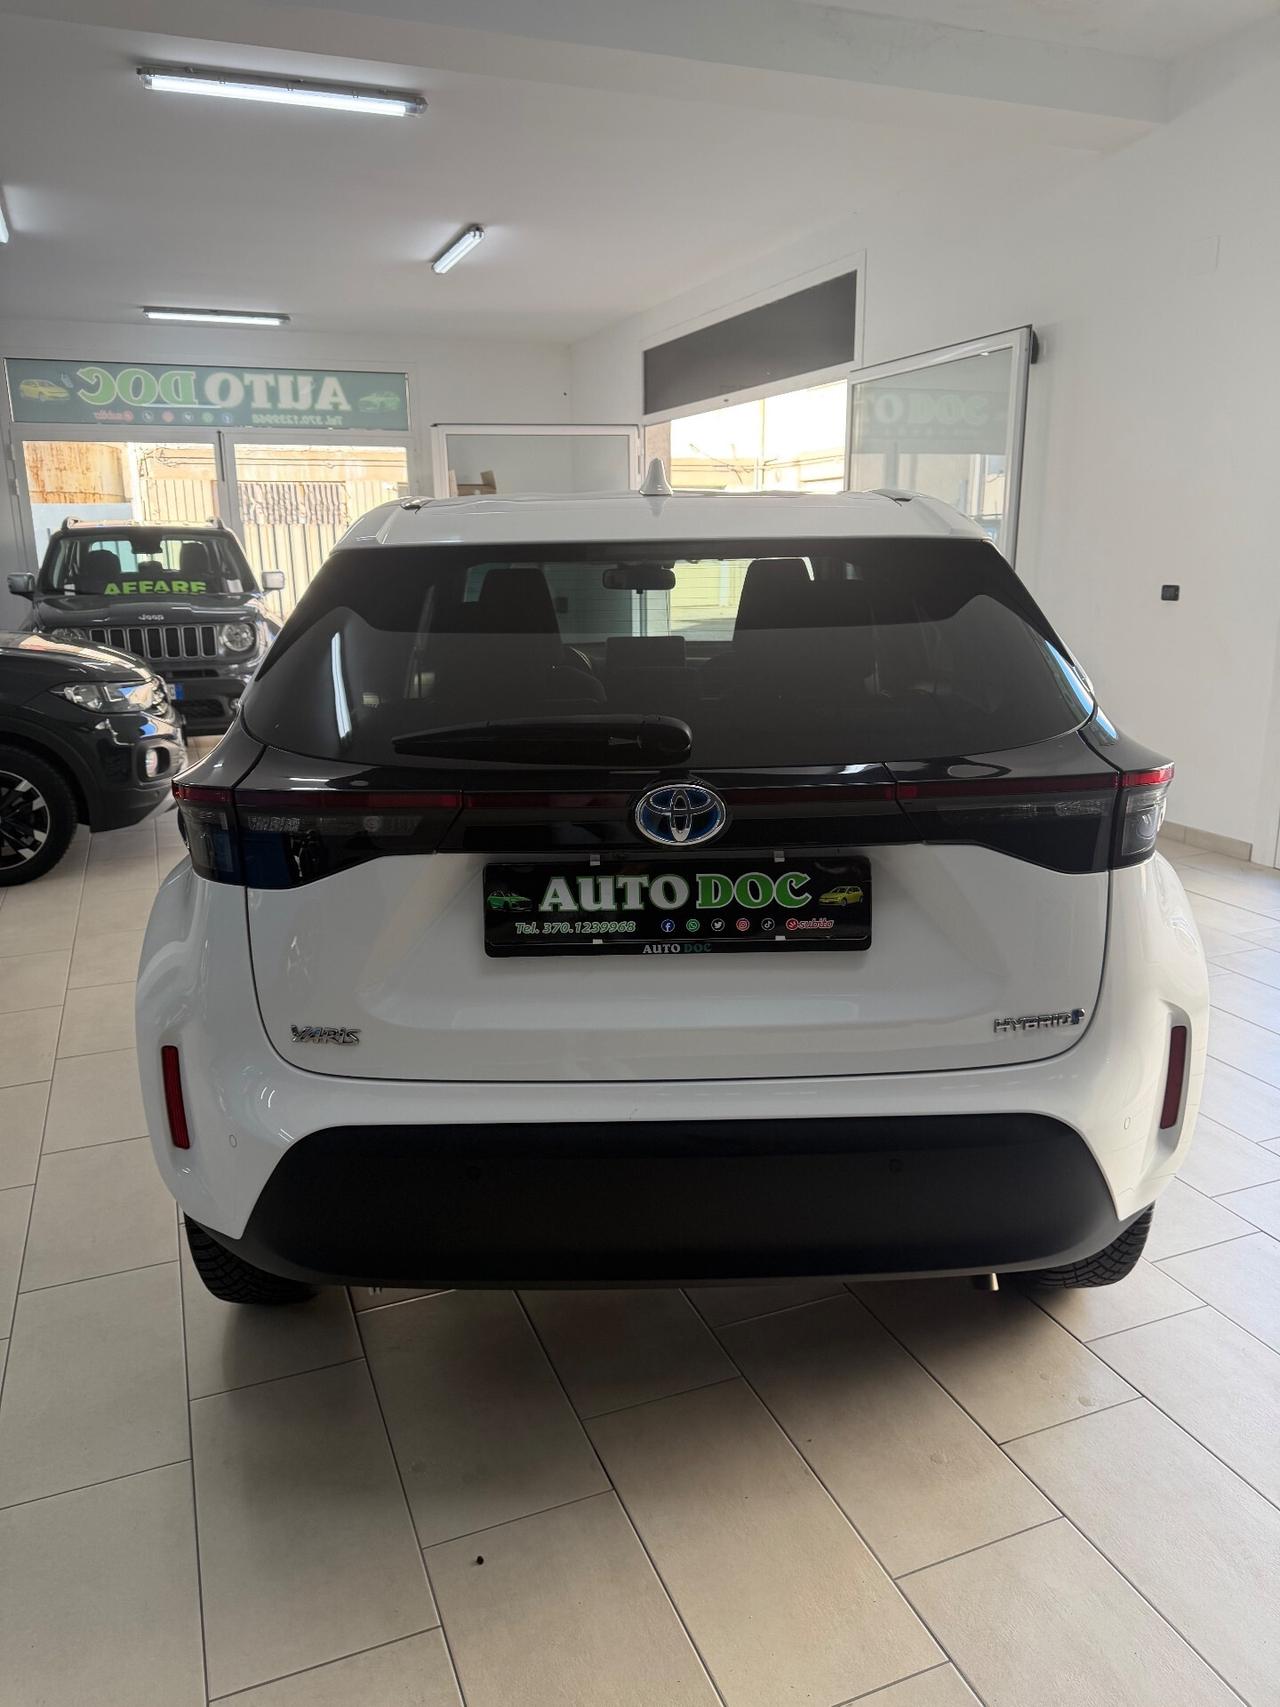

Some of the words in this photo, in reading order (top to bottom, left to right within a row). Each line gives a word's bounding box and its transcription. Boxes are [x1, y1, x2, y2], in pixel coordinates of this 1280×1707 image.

[104, 580, 207, 595] AFFARE
[138, 613, 165, 621] Jeep
[538, 873, 690, 913] AUTO
[696, 872, 813, 909] DOC
[514, 922, 540, 934] Tel.
[542, 921, 637, 934] 370.1239968
[642, 943, 681, 954] AUTO
[993, 1011, 1071, 1033] HYBRID
[290, 1024, 362, 1046] YARIS
